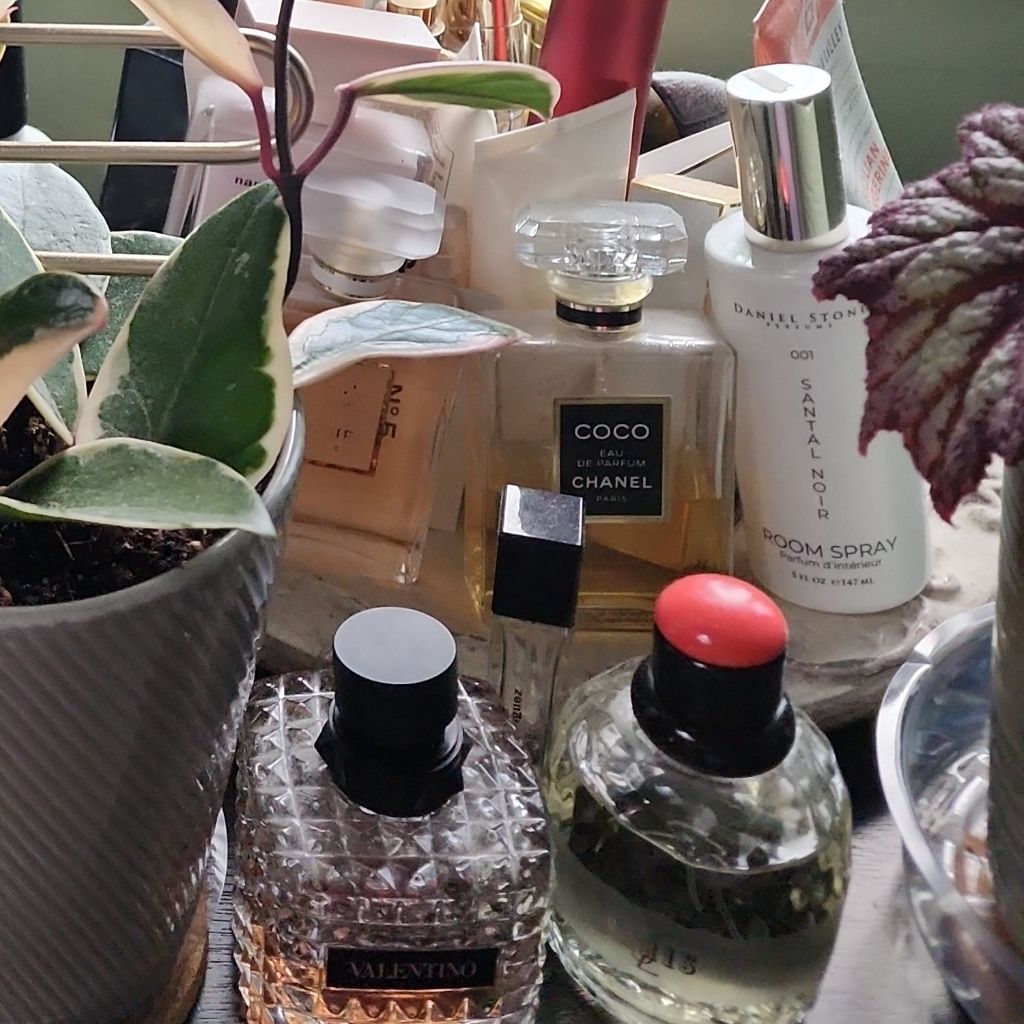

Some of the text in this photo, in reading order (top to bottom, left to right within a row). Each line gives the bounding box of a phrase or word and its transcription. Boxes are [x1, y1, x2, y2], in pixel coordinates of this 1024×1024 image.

[734, 302, 798, 323] DANIEL
[790, 349, 815, 361] 001
[574, 423, 650, 441] COCO
[599, 449, 624, 458] EAU
[800, 378, 829, 521] SANTAL NOIR
[577, 459, 647, 468] DE PARFUM
[571, 476, 653, 489] CHANEL
[596, 495, 628, 503] PARIS
[762, 527, 898, 559] ROOM SPRAY
[779, 549, 820, 569] Parfum
[512, 688, 523, 724] guez
[350, 961, 476, 979] VALENTINO
